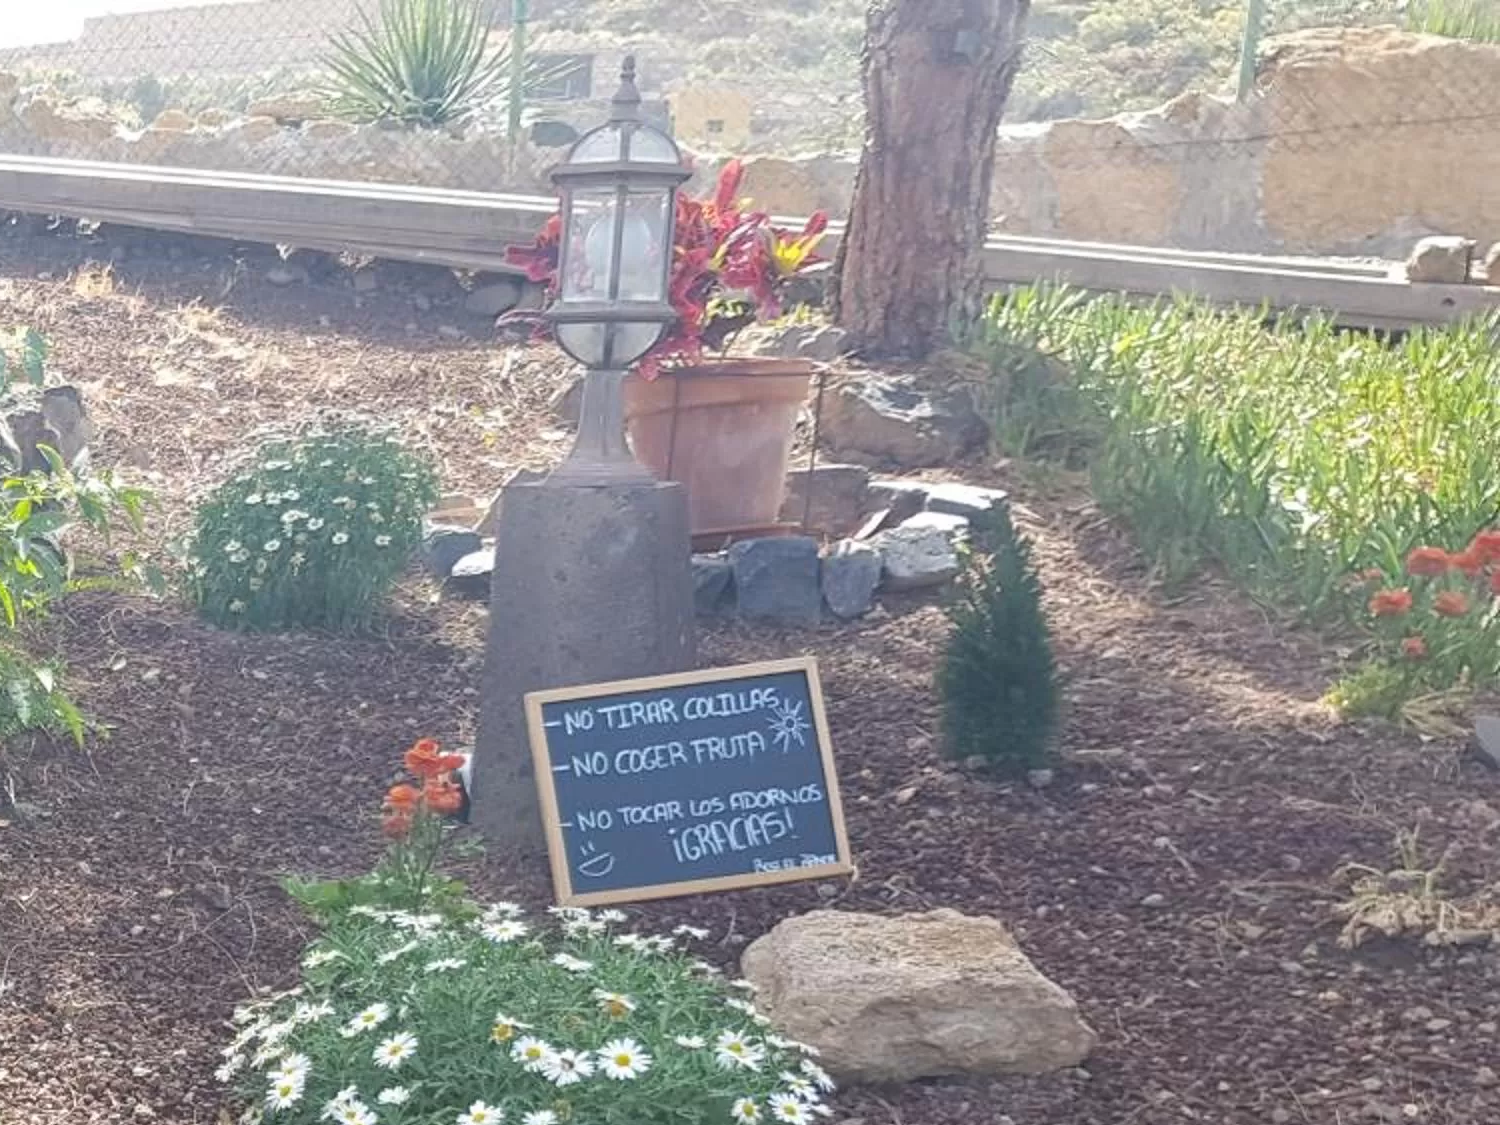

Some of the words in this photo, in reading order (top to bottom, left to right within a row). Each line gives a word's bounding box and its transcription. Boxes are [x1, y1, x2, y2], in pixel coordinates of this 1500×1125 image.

[598, 698, 678, 728] TIRAR
[683, 687, 779, 719] COLILLAS
[614, 742, 687, 774] COGER
[691, 731, 765, 763] FRUTA
[618, 803, 683, 825] TOCAR
[689, 797, 724, 816] LOS
[730, 784, 822, 812] ADORNOS
[668, 811, 799, 862] ¡GRACIAS!
